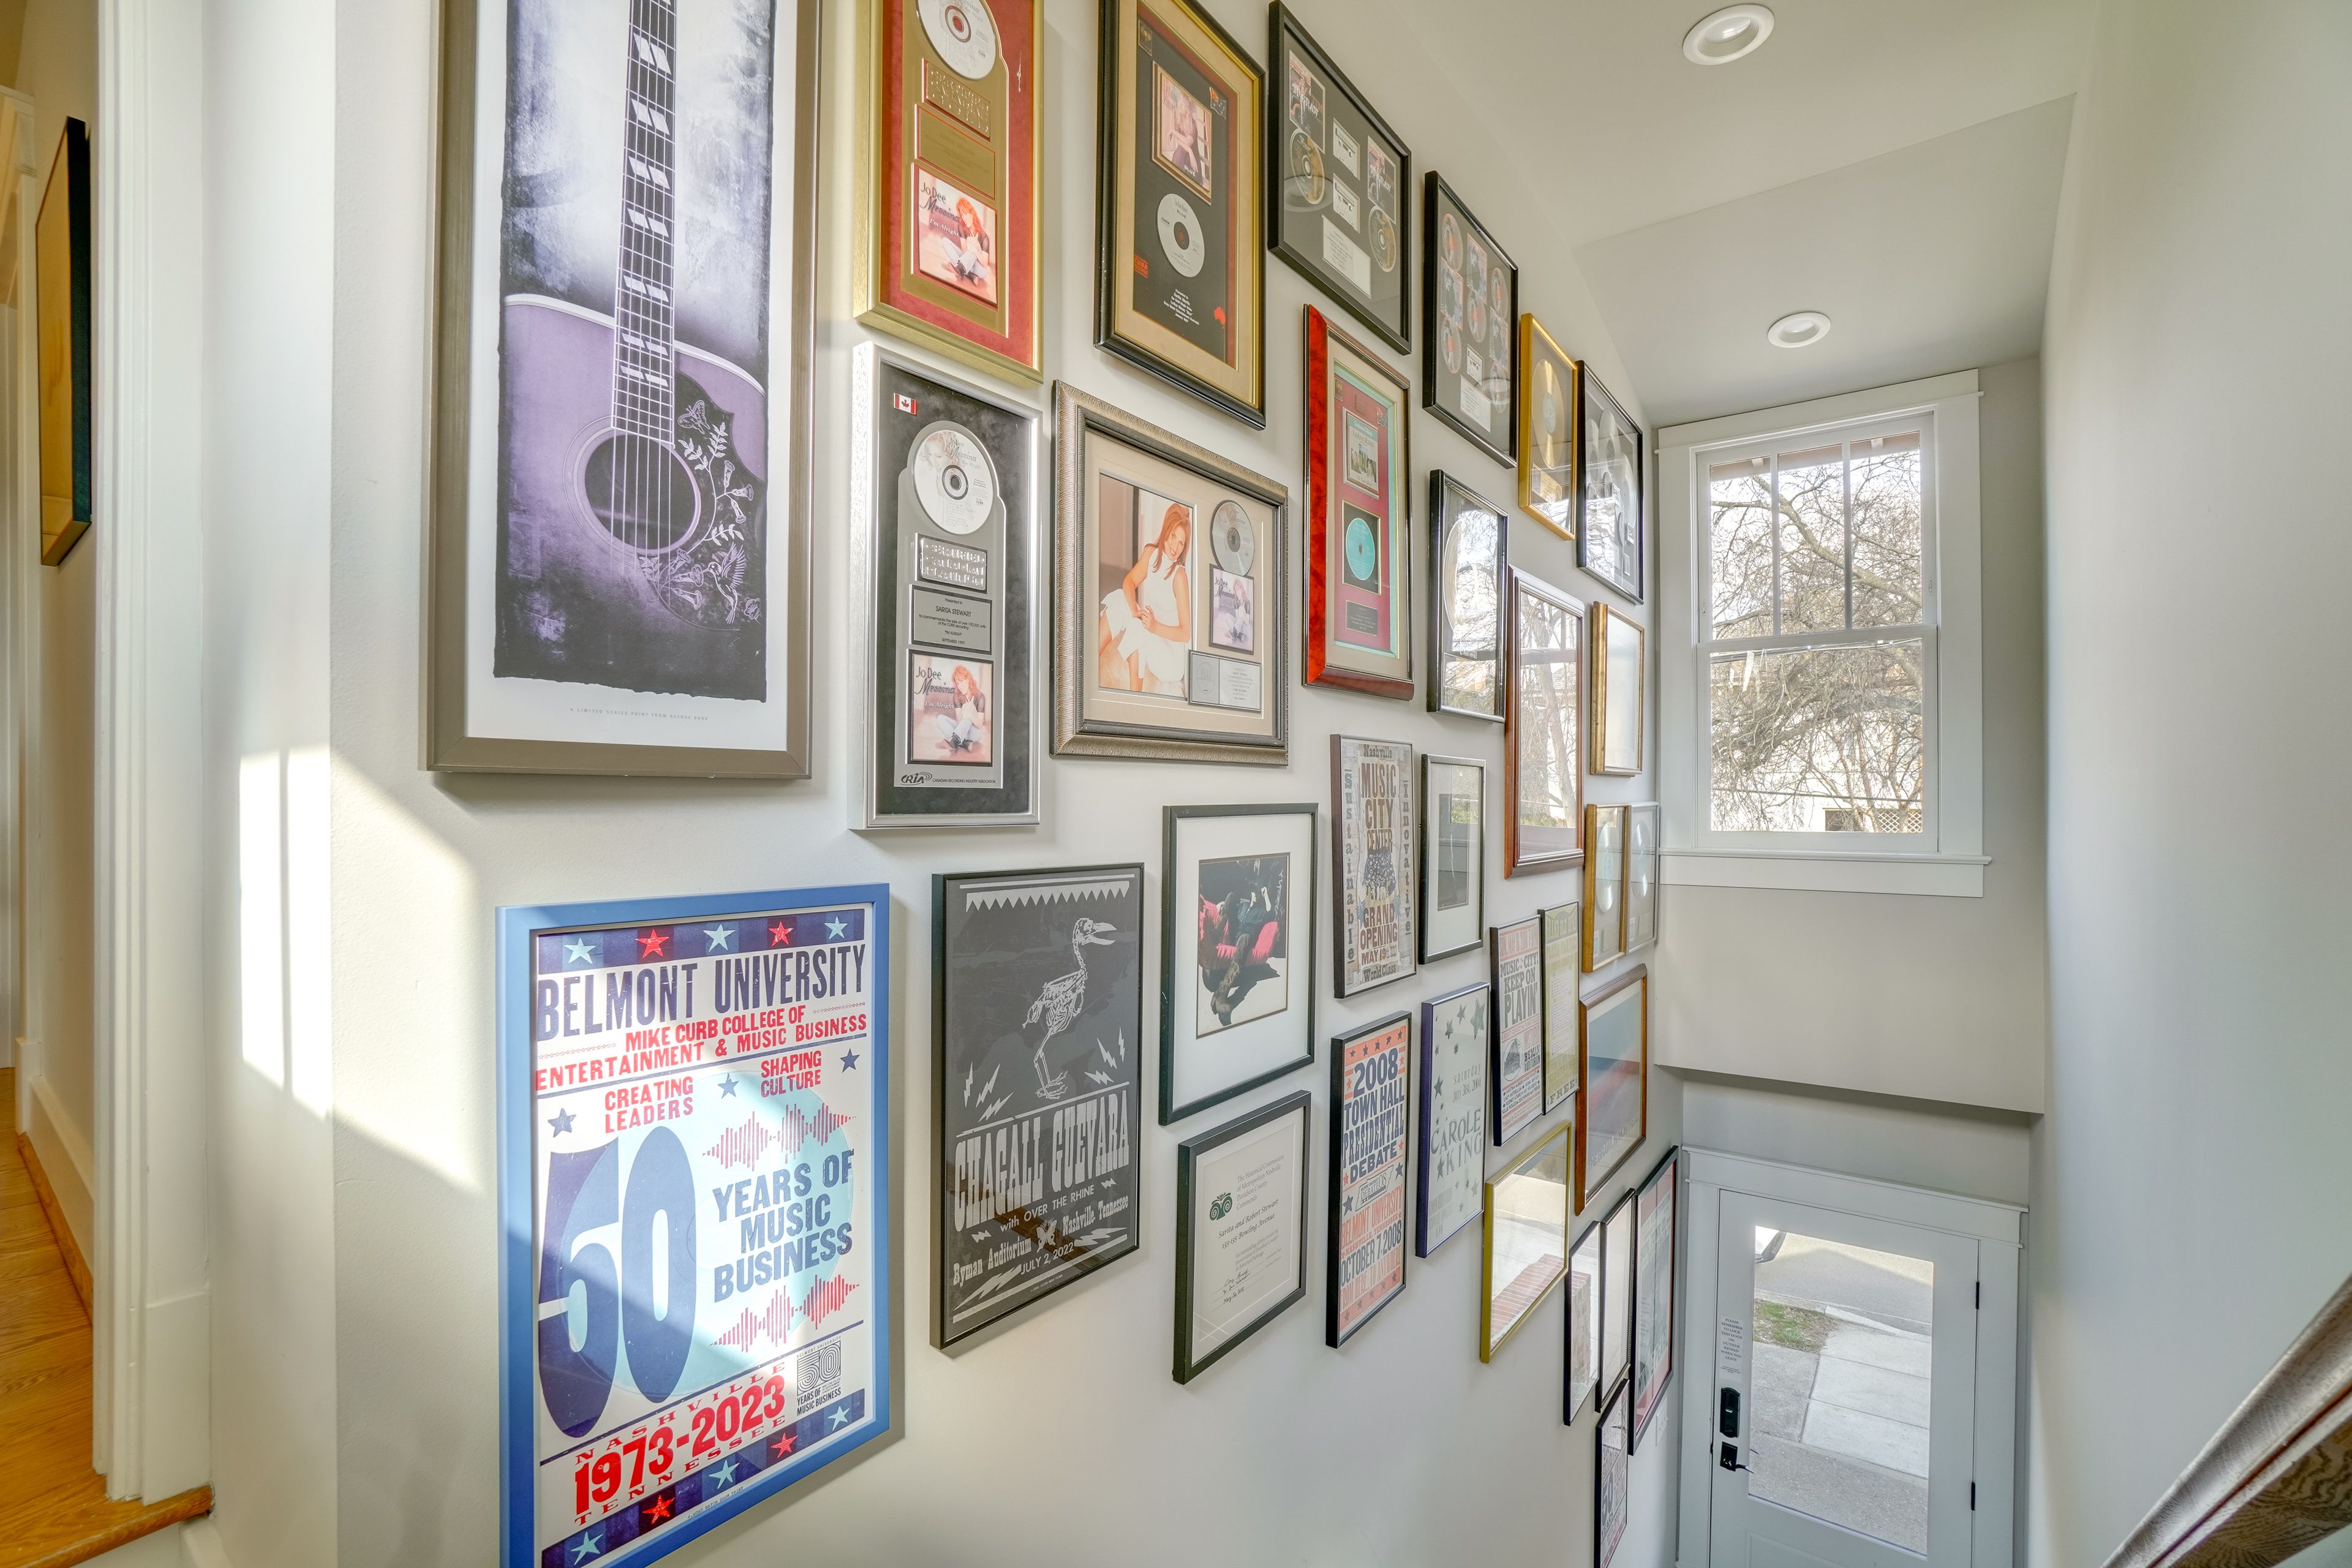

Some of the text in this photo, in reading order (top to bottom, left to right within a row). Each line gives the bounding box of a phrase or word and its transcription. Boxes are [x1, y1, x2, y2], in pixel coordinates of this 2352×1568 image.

[1185, 165, 1196, 177] BLUE
[921, 182, 946, 205] Jo Dee
[940, 224, 959, 236] Alright
[936, 605, 971, 617] SARITA STEWART
[914, 677, 956, 696] Messina
[916, 666, 941, 680] Jo Dee
[935, 701, 954, 710] Alright
[1363, 745, 1392, 759] Nashville
[1361, 763, 1396, 799] MUSIC
[1365, 798, 1394, 829] CITY
[1366, 829, 1393, 853] CENTER
[1362, 903, 1395, 928] GRAND
[1360, 922, 1398, 951] OPENING
[1361, 949, 1379, 966] MAY
[1363, 963, 1396, 982] World Class
[1500, 951, 1539, 978] MUSIC CITY!
[537, 944, 866, 1042] BELMONT UNIVERSITY
[1504, 966, 1536, 995] KEEP ON
[1504, 982, 1538, 1029] PLAYIN'
[625, 1005, 806, 1053] MIKE CURB COLLEGE OF
[536, 1014, 867, 1091] ENTERTAINMENT & MUSIC BUSINESS
[761, 1050, 823, 1078] SHAPING
[1524, 1043, 1540, 1062] RYMAN
[761, 1069, 823, 1098] CULTURE
[1353, 1047, 1398, 1099] 2008
[1453, 1063, 1481, 1085] saturday
[604, 1076, 693, 1112] CREATING
[1344, 1077, 1405, 1131] TOWN HALL
[604, 1096, 694, 1134] LEADERS
[1430, 1107, 1482, 1155] CAROLE
[1343, 1102, 1404, 1170] PRESIDENTIAL
[954, 1089, 1129, 1232] CHAGALL GUEVARA
[1245, 1164, 1263, 1178] Historical
[1263, 1155, 1284, 1169] Commission
[1350, 1139, 1397, 1184] DEBATE
[1446, 1131, 1482, 1177] KING
[712, 1149, 854, 1223] YEARS OF
[1237, 1180, 1268, 1201] Davidson County
[1242, 1174, 1265, 1191] Metropolitan
[1265, 1163, 1282, 1177] Nashville
[1000, 1185, 1095, 1232] with OVER THE RHINE
[1218, 1199, 1278, 1238] Sarita and Robert Stewart
[1236, 1194, 1258, 1210] Commends
[1341, 1205, 1370, 1250] BELMONT
[1371, 1185, 1403, 1229] UNIVERSITY
[740, 1193, 831, 1254] MUSIC
[1222, 1213, 1275, 1250] 133-135 Bowling Avenue
[1373, 1214, 1399, 1235] TENNESSEE
[952, 1257, 984, 1287] Ryman
[987, 1237, 1031, 1270] Auditorium
[1098, 1195, 1129, 1220] Tennessee
[1020, 1241, 1074, 1275] JULY 2, 2022
[714, 1221, 853, 1303] BUSINESS
[1341, 1238, 1375, 1287] OCTOBER
[538, 1125, 697, 1438] 50
[796, 1335, 842, 1359] BELMONT UNIVERSITY
[797, 1340, 841, 1396] 50
[574, 1362, 785, 1465] NASHVILLE
[797, 1387, 821, 1406] YEARS OF
[797, 1387, 842, 1417] MUSIC BUSINESS
[574, 1374, 786, 1515] 1973-2023
[574, 1415, 785, 1526] TENNESSEE
